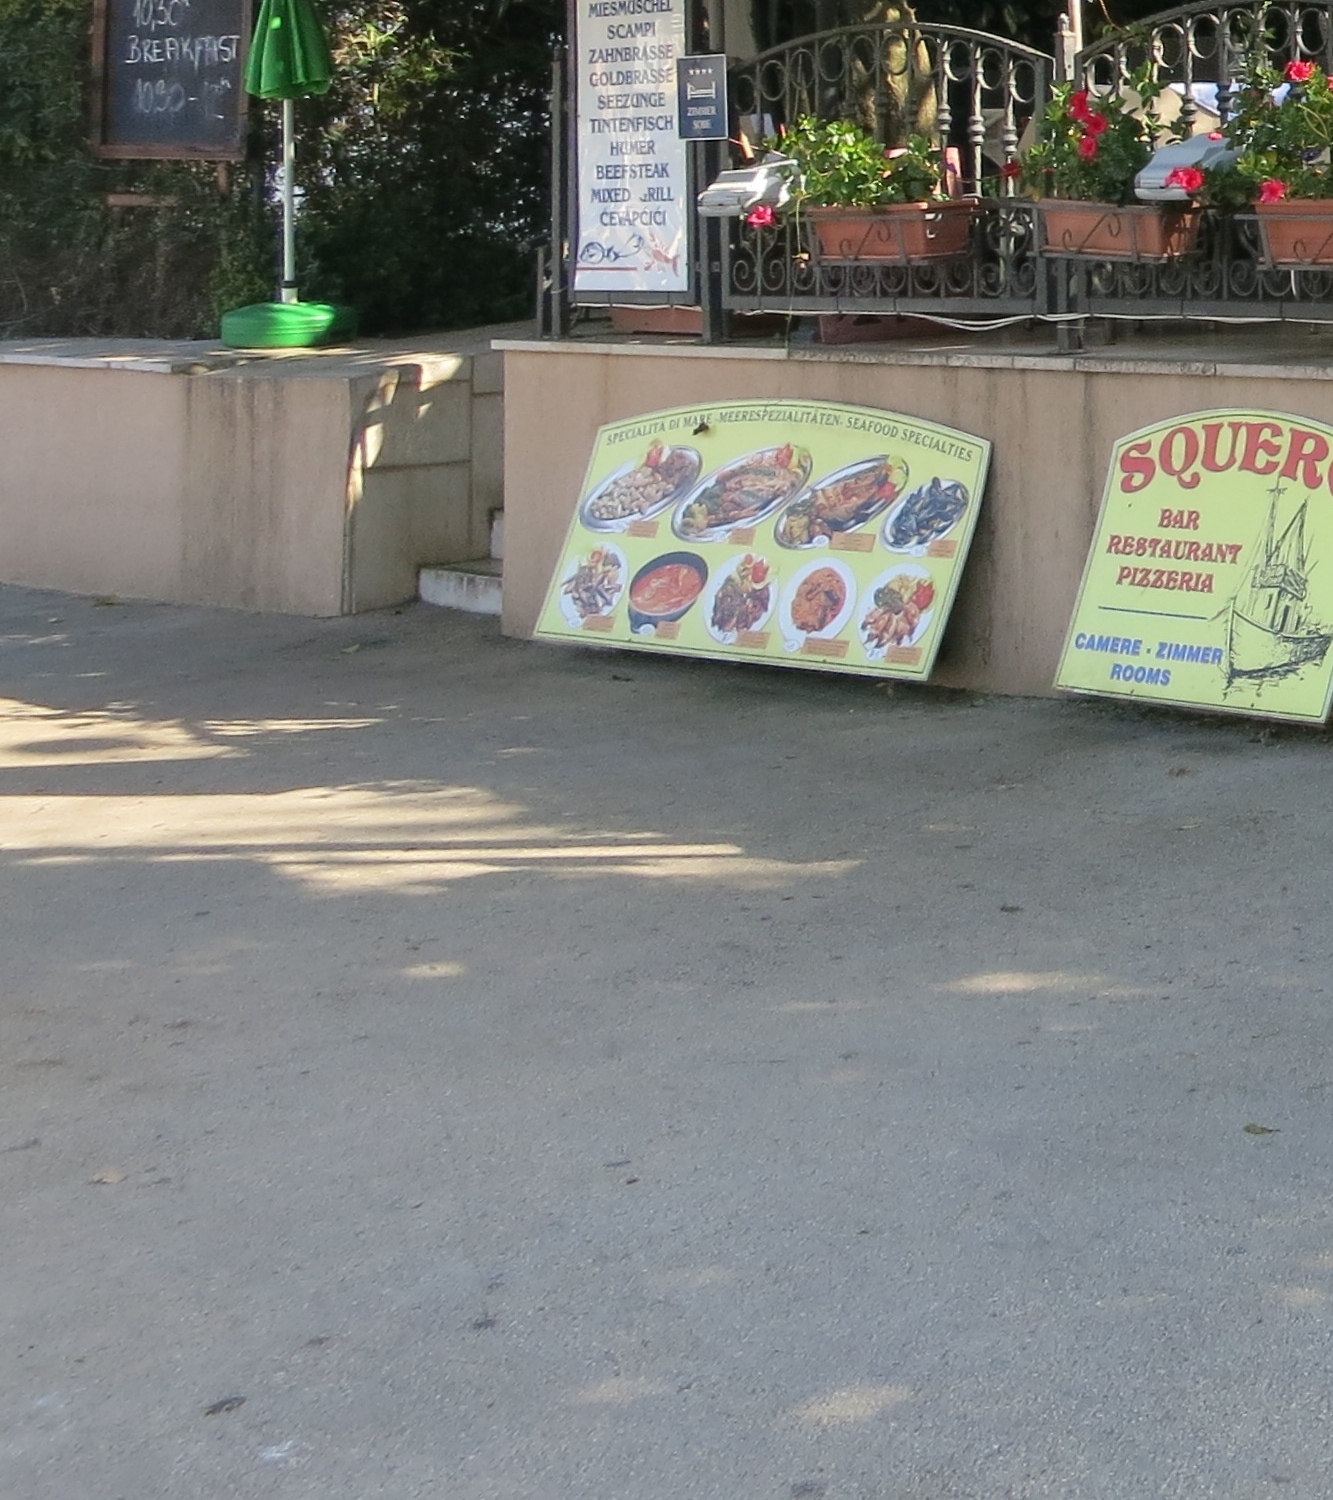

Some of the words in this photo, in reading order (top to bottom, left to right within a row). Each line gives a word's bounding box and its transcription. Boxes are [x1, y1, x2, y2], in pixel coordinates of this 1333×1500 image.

[607, 21, 656, 40] SCAMPI
[125, 35, 240, 70] BREAKFAST
[588, 44, 673, 64] ZAHNBRASSE
[589, 68, 673, 87] GOLDBRASSE
[597, 92, 665, 110] SEEZUNGE
[589, 115, 673, 133] TINTENFISCH
[596, 163, 669, 180] BEEFSTEAK
[590, 187, 631, 203] MIXED
[669, 418, 680, 430] DI
[683, 413, 712, 429] MARE
[847, 417, 898, 438] SEAFOOD
[901, 428, 973, 462] SPECIALTIES
[1159, 508, 1200, 530] BAR
[1106, 534, 1243, 565] RESTAURANT
[1116, 566, 1214, 594] PIZZERIA
[1075, 632, 1143, 657] CAMERE
[1155, 644, 1224, 665] ZIMMER
[1110, 663, 1171, 687] ROOMS
